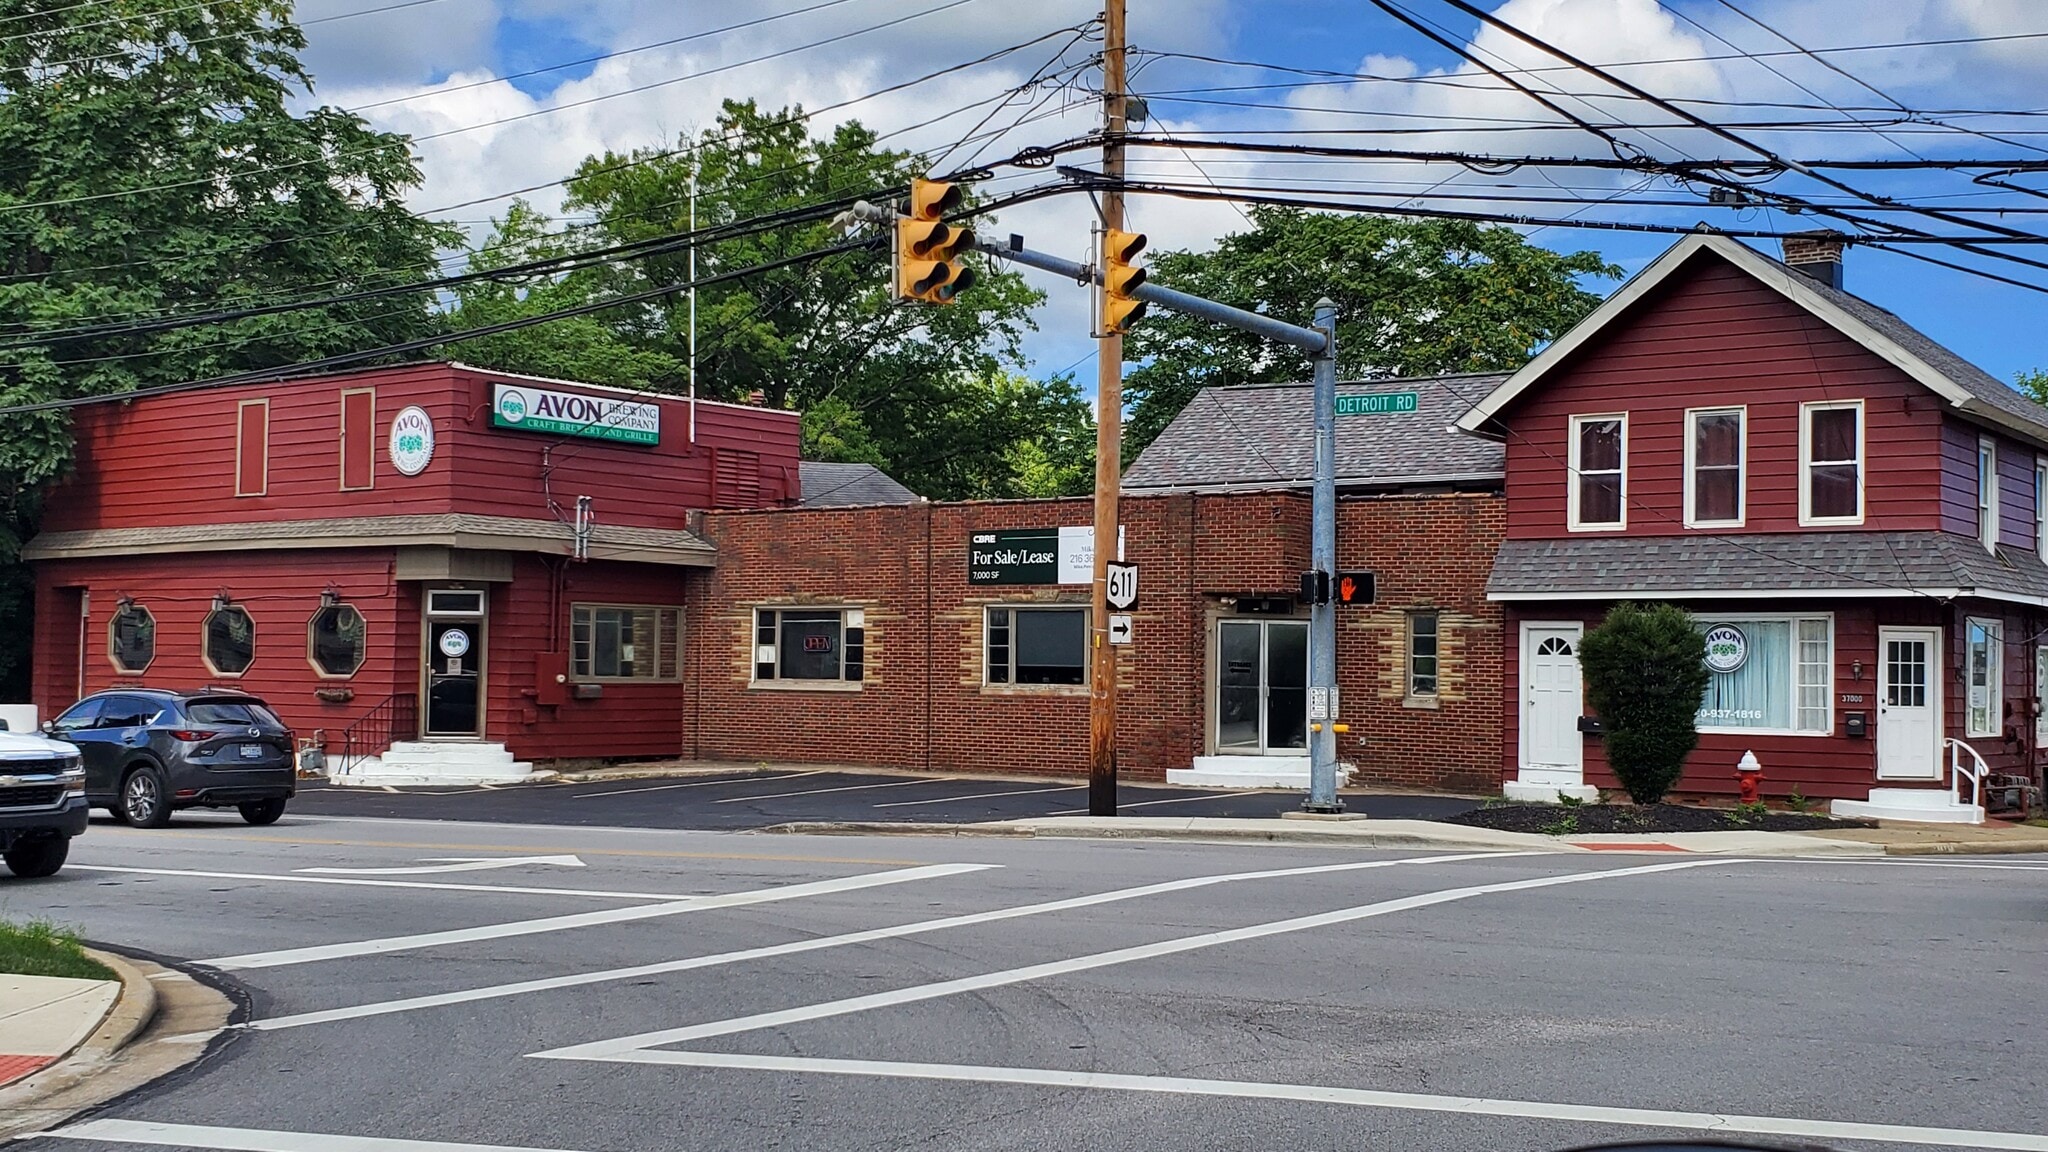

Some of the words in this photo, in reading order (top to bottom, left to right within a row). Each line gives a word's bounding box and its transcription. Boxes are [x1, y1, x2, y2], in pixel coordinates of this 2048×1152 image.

[534, 394, 604, 423] AVON
[609, 403, 657, 419] BREWING
[1339, 396, 1389, 412] DETROIT
[1396, 395, 1413, 410] RD
[395, 414, 428, 438] AVON
[527, 419, 556, 430] CRAFT
[559, 422, 600, 435] BREWERY
[604, 430, 622, 438] AND
[624, 432, 654, 442] GRILLE
[608, 415, 657, 430] COMPANY
[973, 534, 996, 543] CBRE
[973, 550, 993, 565] For
[994, 549, 1055, 566] Sale/Lease
[1070, 554, 1083, 563] 216
[972, 571, 991, 580] 7,000
[991, 571, 1000, 579] SF
[1109, 571, 1132, 598] 611
[1706, 630, 1741, 646] AVON
